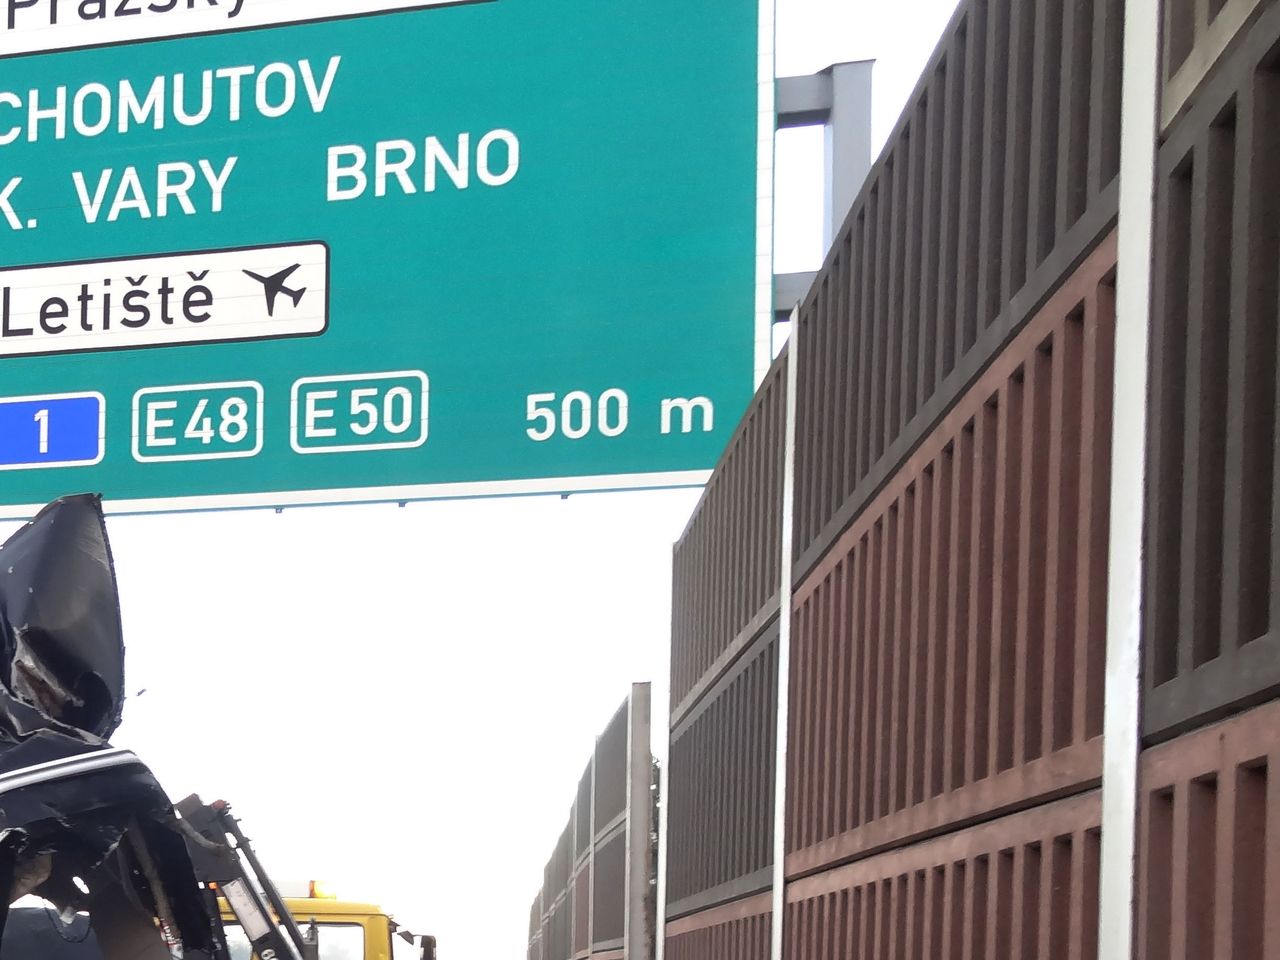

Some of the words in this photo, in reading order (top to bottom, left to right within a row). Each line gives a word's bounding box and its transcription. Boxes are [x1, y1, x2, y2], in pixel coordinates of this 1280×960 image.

[72, 156, 238, 224] VARY
[326, 128, 520, 202] BRNO
[2, 269, 214, 338] Letiště
[34, 408, 49, 454] 1
[526, 387, 629, 441] 500
[660, 396, 714, 434] m
